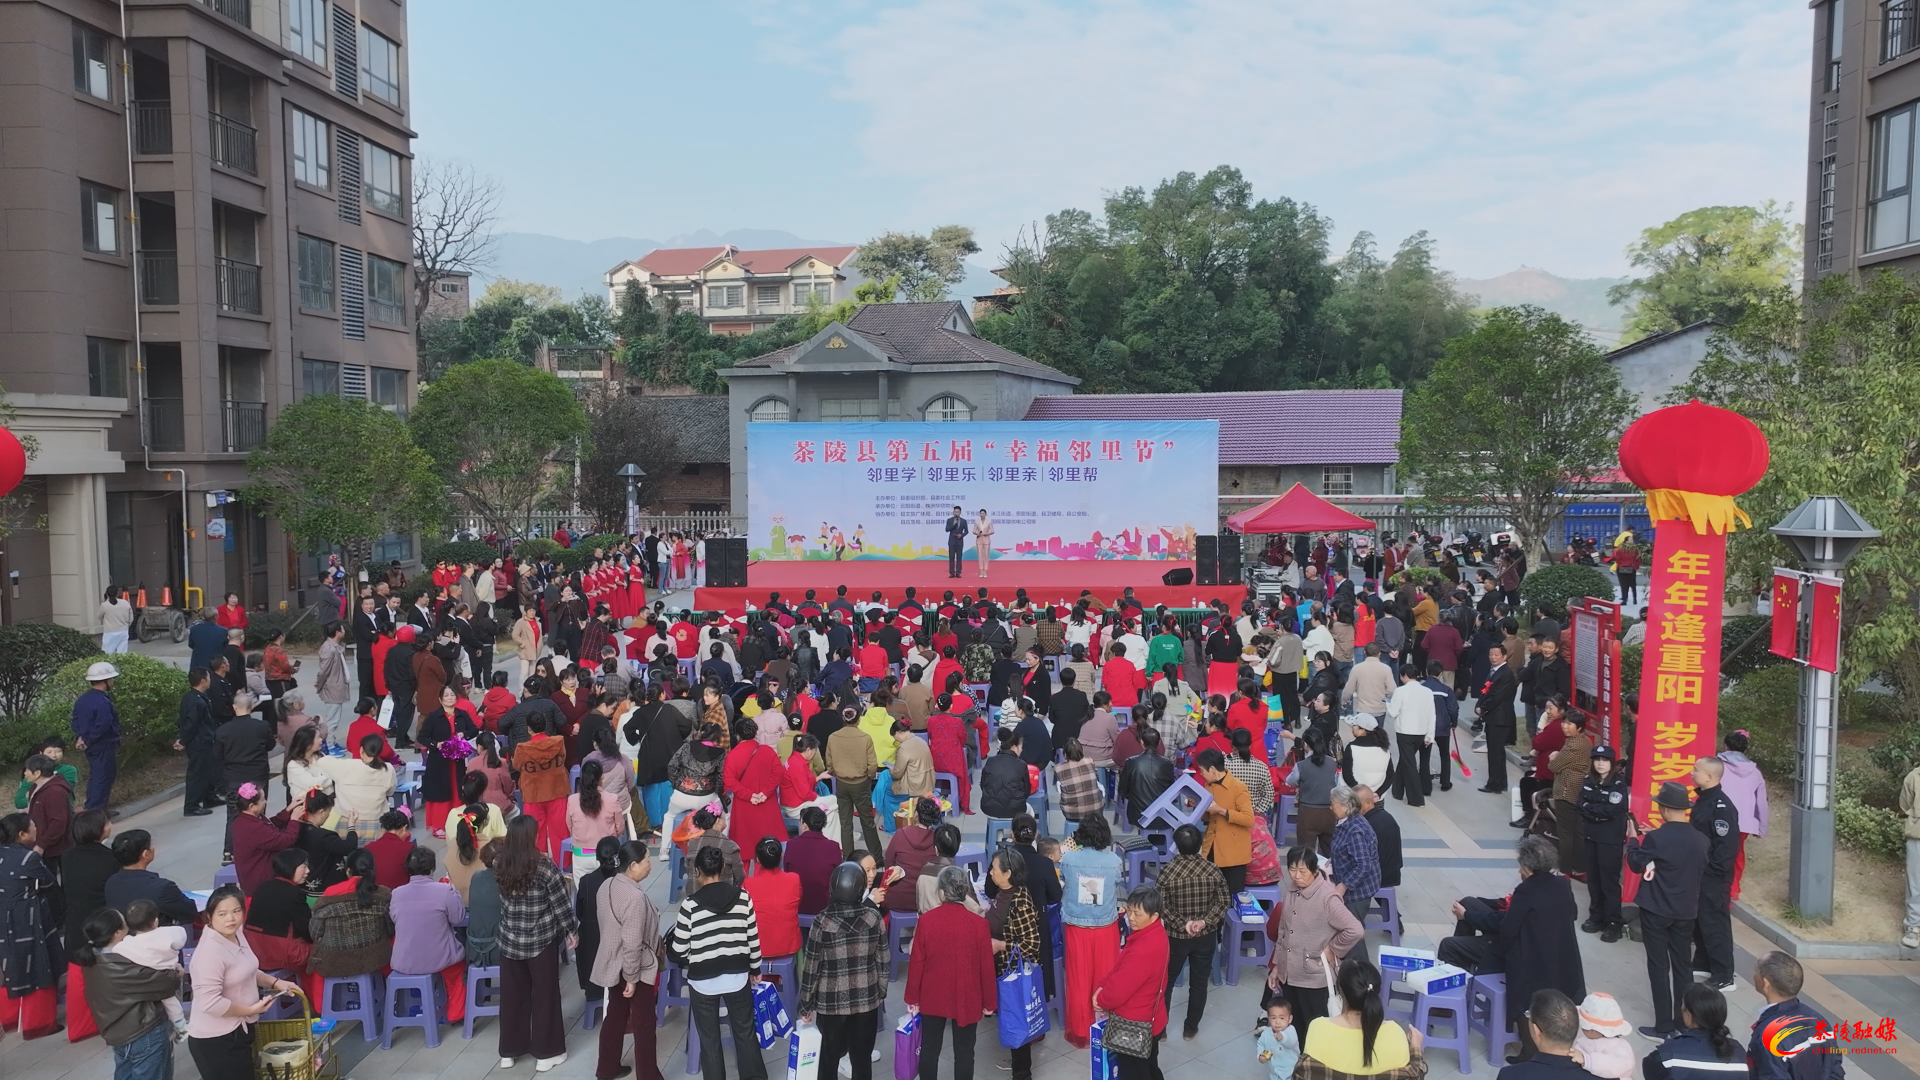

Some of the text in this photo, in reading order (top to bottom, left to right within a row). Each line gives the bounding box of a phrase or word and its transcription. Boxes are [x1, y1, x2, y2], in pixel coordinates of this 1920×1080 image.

[792, 438, 1176, 463] 茶陵县第五届“幸福邻里节”
[867, 466, 1099, 483] 邻里学 邻里乐 邻里亲 邻里帮
[1655, 550, 1711, 704] 年年逢重阳
